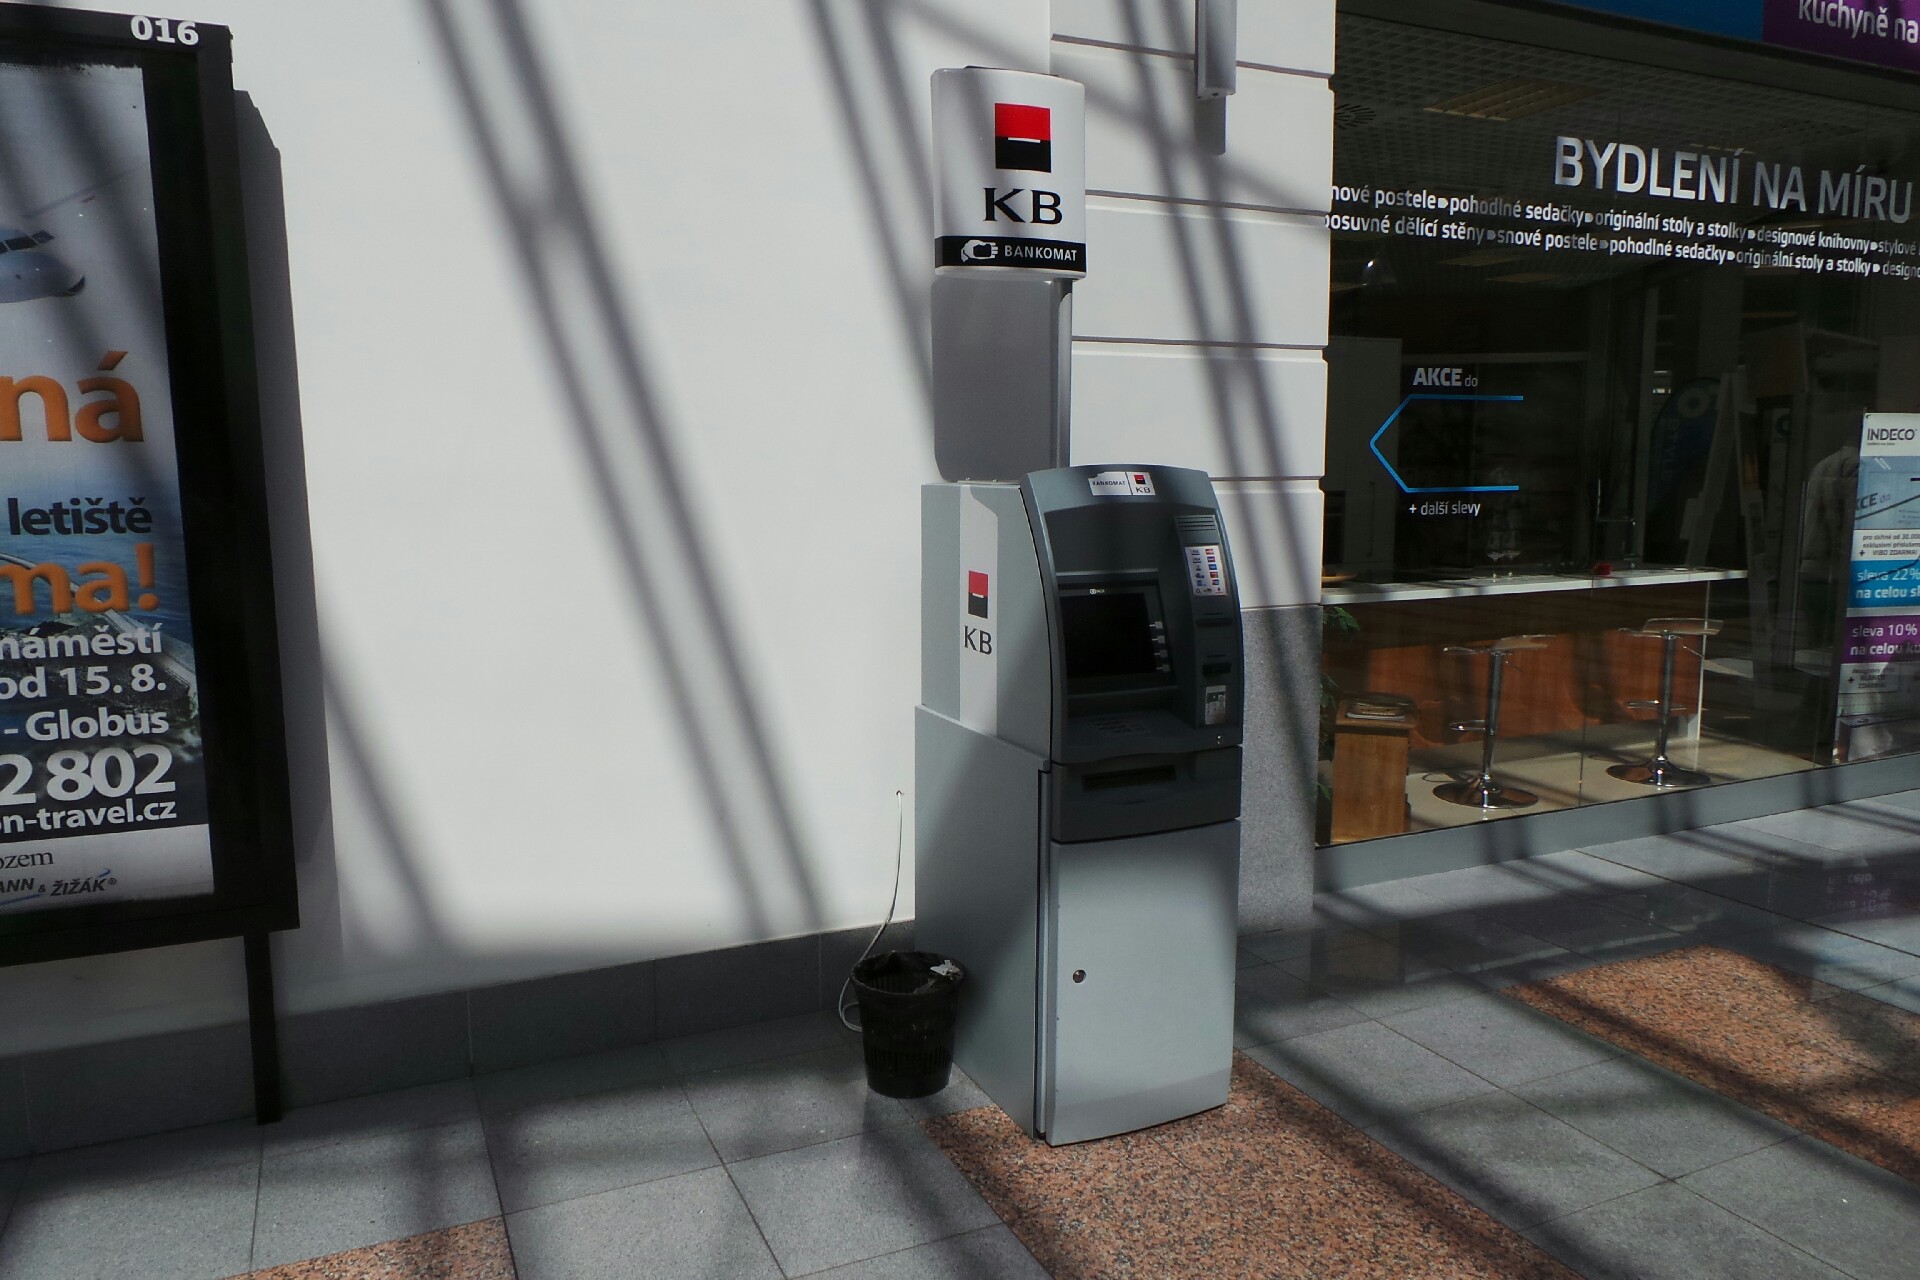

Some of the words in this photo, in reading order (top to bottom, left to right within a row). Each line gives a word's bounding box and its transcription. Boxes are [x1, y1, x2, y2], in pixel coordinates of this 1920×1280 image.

[131, 15, 199, 46] 016
[1894, 18, 1918, 43] na
[1554, 136, 1744, 204] BYDLENÍ
[1753, 161, 1807, 212] NA
[1817, 165, 1913, 224] MÍRU
[983, 187, 1062, 225] KB
[1375, 189, 1436, 209] postele
[1449, 195, 1522, 218] pohodlné
[1525, 203, 1585, 228] sedačky
[1595, 209, 1660, 231] originální
[1662, 216, 1694, 238] stoly
[1697, 222, 1705, 235] a
[1707, 221, 1747, 243] stolky
[1757, 226, 1816, 248] designové
[1818, 231, 1871, 254] knihovny
[1878, 239, 1917, 256] stylové
[1004, 244, 1078, 262] BANKOMAT
[1395, 216, 1439, 237] dělící
[1442, 221, 1485, 245] stěny
[1497, 229, 1541, 246] snové
[1545, 233, 1597, 251] postele
[1609, 236, 1672, 256] pohodlné
[1675, 243, 1726, 265] sedačky
[1736, 248, 1794, 268] originální
[1795, 254, 1824, 273] stoly
[1826, 258, 1834, 270] a
[1837, 257, 1871, 276] stolky
[1413, 368, 1462, 386] AKCE
[1465, 375, 1478, 387] do
[1867, 428, 1915, 441] INDECO
[8, 497, 153, 535] letiště
[1420, 501, 1449, 515] další
[1452, 501, 1480, 516] slevy
[1857, 569, 1888, 581] sleva
[1856, 589, 1871, 598] na
[1874, 586, 1907, 598] celou
[0, 622, 162, 660] náměstí
[964, 625, 992, 655] KB
[1852, 624, 1884, 637] sleva
[1850, 646, 1865, 656] na
[1869, 642, 1902, 655] celou
[0, 666, 47, 699] od
[26, 706, 169, 741] Globus
[0, 798, 177, 834] n-travel.cz
[38, 884, 46, 893] &
